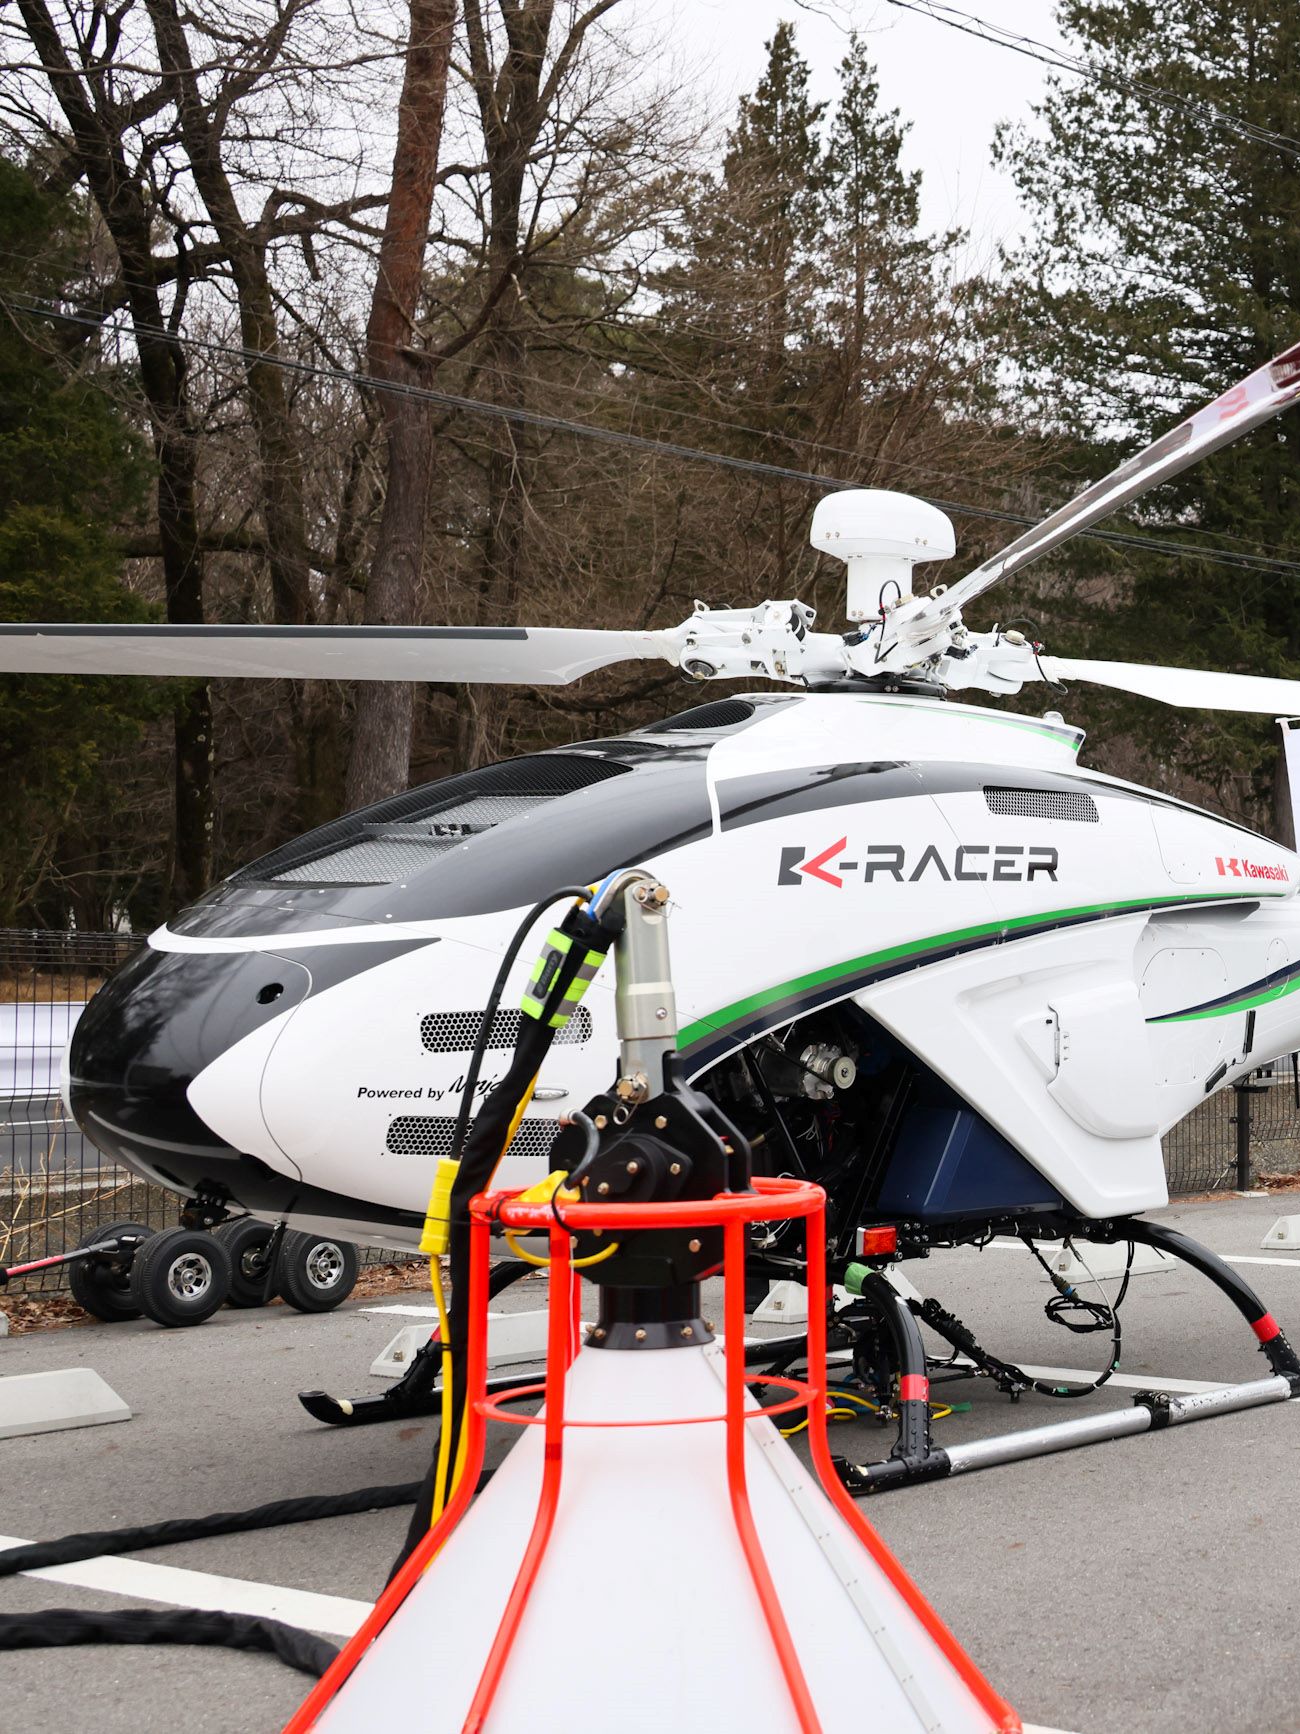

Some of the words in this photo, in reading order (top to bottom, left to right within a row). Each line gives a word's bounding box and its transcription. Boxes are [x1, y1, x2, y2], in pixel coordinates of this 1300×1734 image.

[777, 836, 1059, 889] K-RACER
[1241, 859, 1290, 882] Kawasaki
[357, 1087, 422, 1099] Powered
[427, 1087, 445, 1101] by
